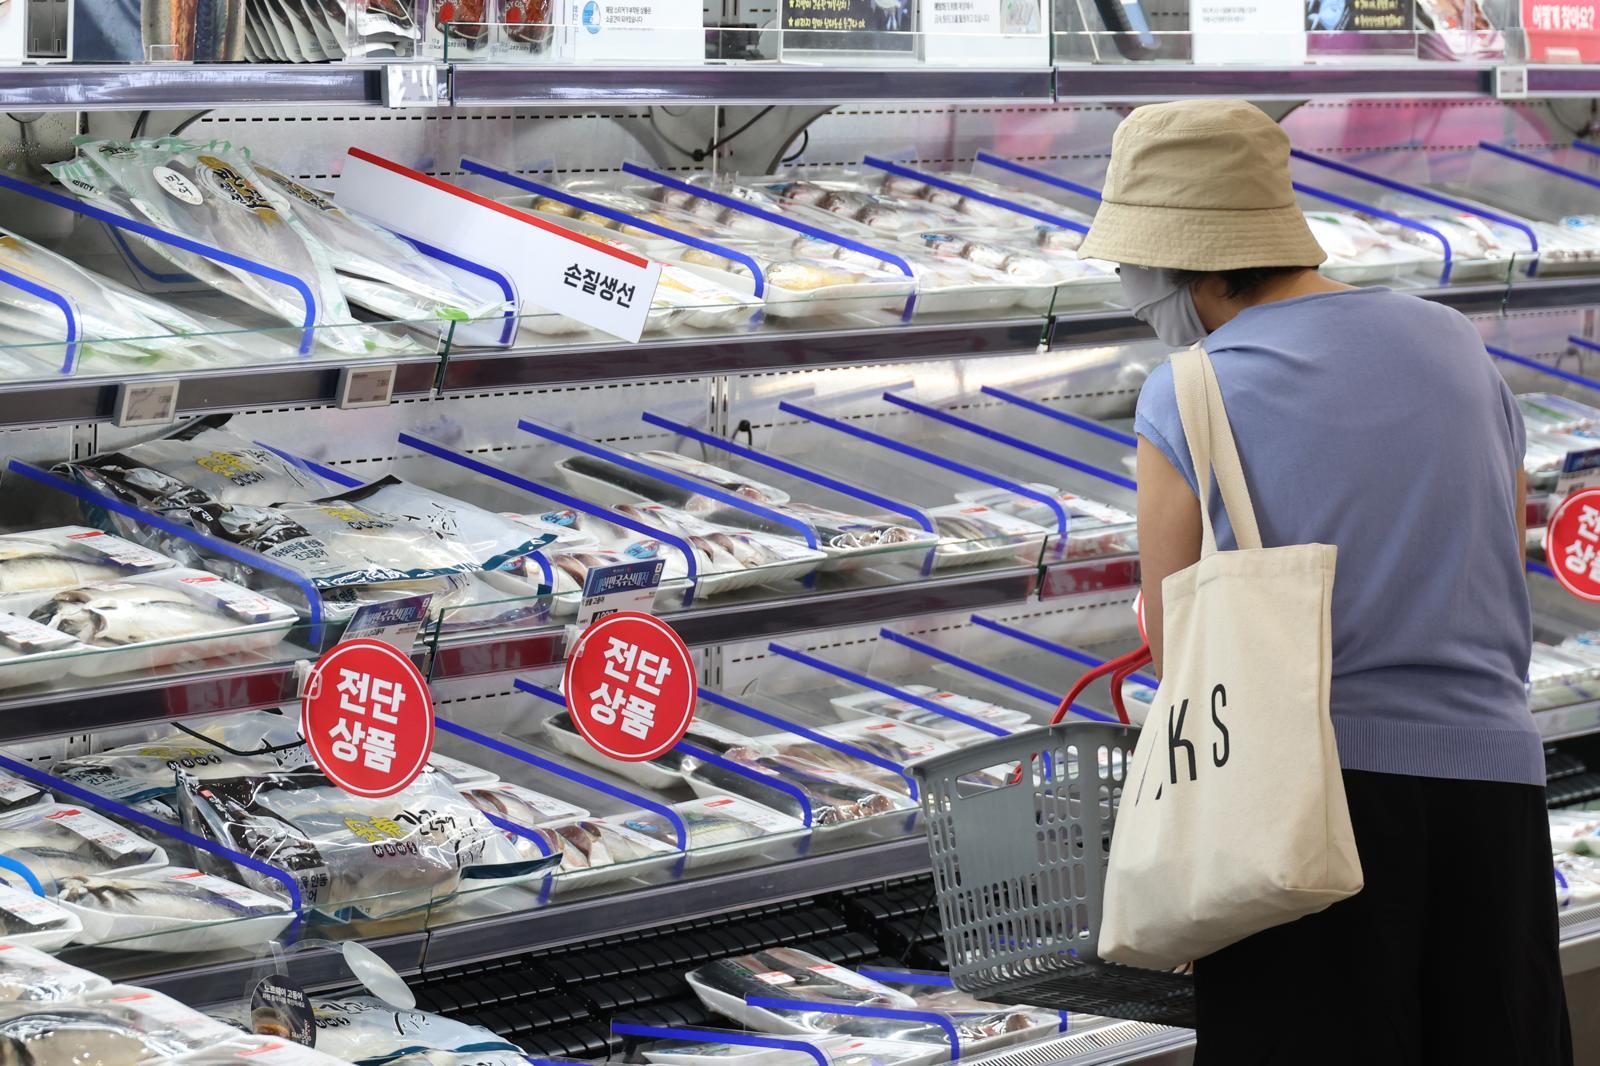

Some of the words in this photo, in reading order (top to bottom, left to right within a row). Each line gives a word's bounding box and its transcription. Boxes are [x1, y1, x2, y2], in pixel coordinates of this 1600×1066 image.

[564, 263, 636, 309] 손질생선
[603, 636, 672, 696] 전단
[336, 668, 407, 725] 전단
[589, 682, 656, 741] 상품
[328, 717, 397, 773] 상품
[1155, 683, 1230, 800] KS
